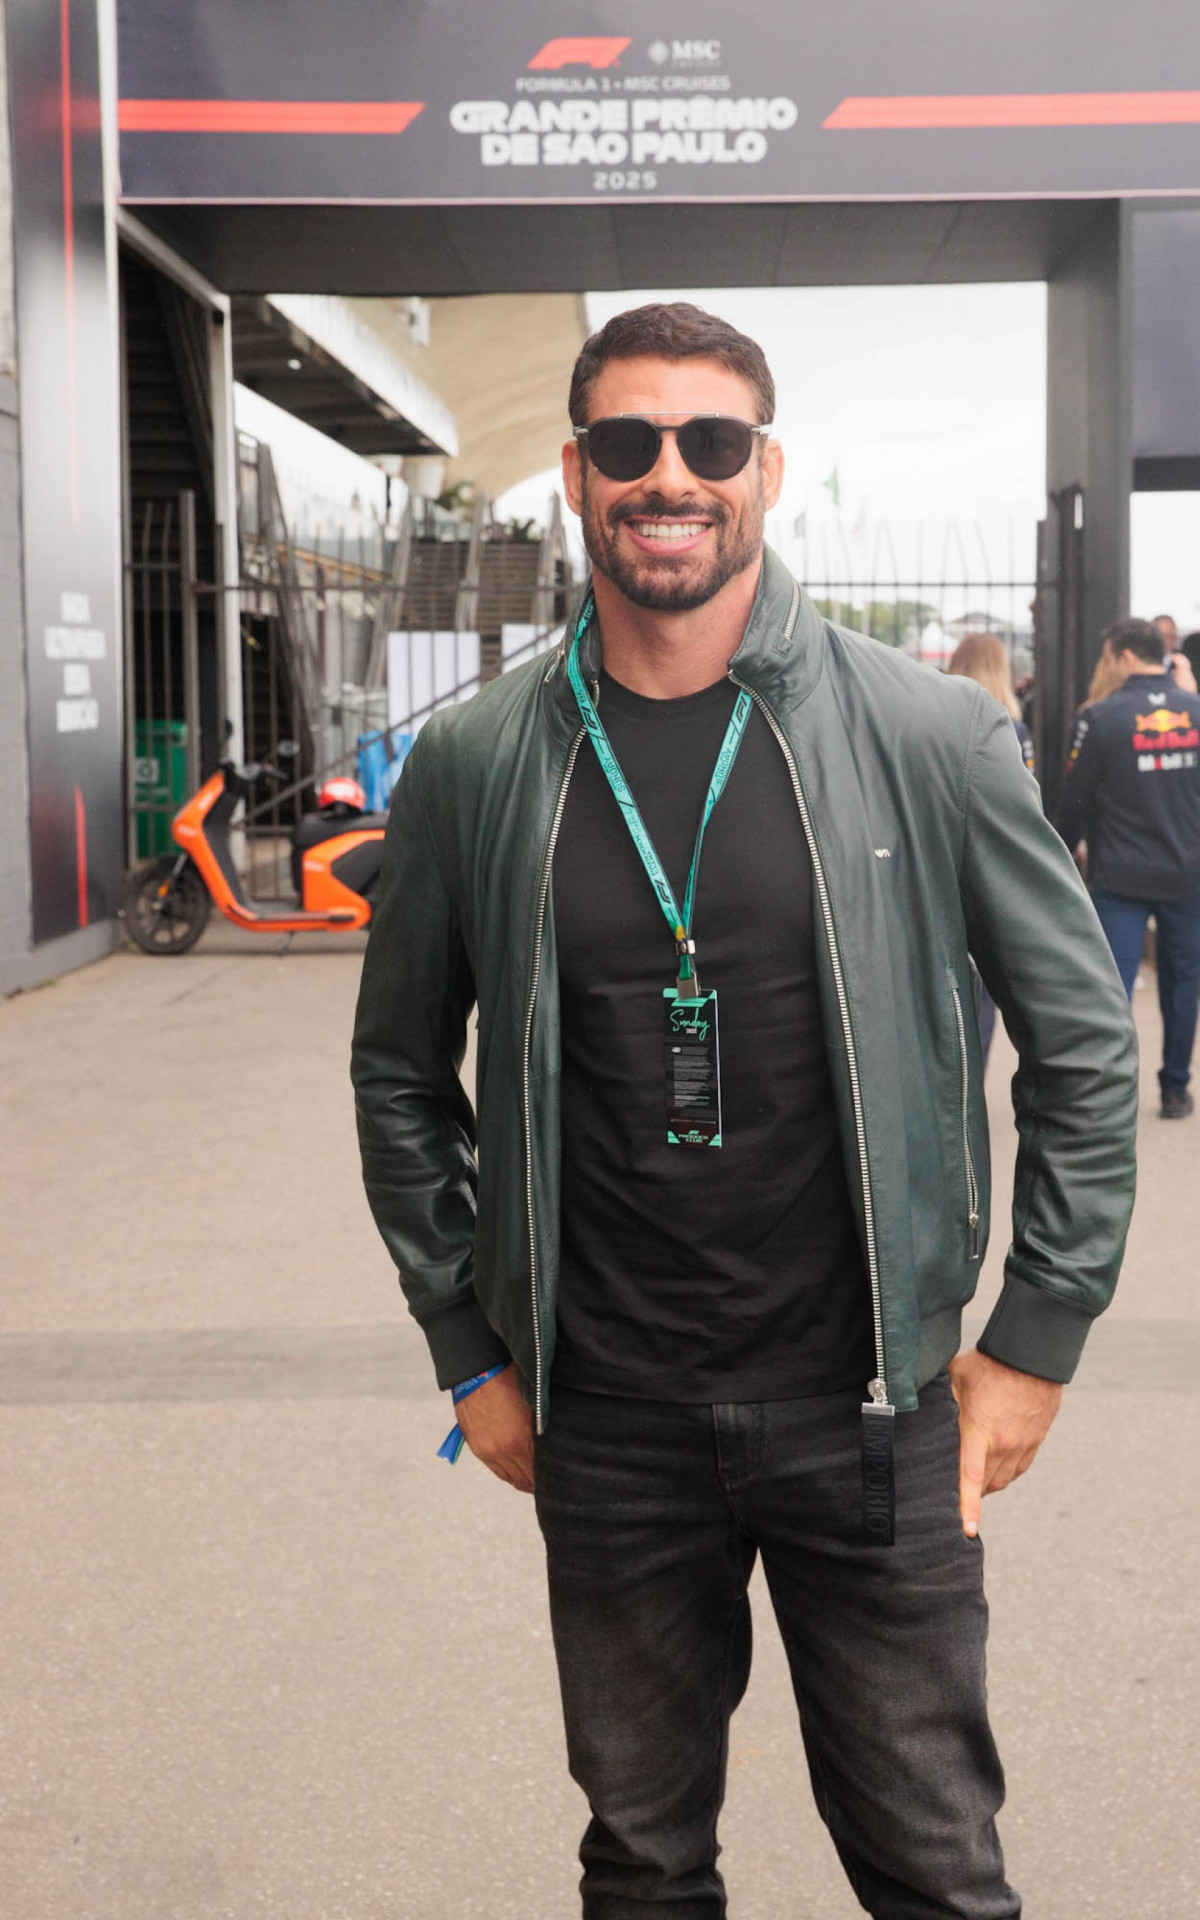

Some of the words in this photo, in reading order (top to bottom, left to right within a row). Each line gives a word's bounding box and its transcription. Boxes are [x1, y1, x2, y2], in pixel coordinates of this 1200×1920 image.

[672, 40, 720, 60] MSC
[515, 77, 598, 92] FORMULA
[601, 77, 611, 92] 1
[623, 76, 660, 91] MSC
[661, 75, 731, 91] CRUISES
[449, 100, 628, 133] GRANDE
[480, 133, 539, 166] DE
[632, 130, 768, 164] PAULO
[593, 171, 657, 190] 2025
[604, 757, 626, 793] SUNDAY
[715, 748, 733, 785] SUNDAY
[670, 1007, 711, 1041] Sunday
